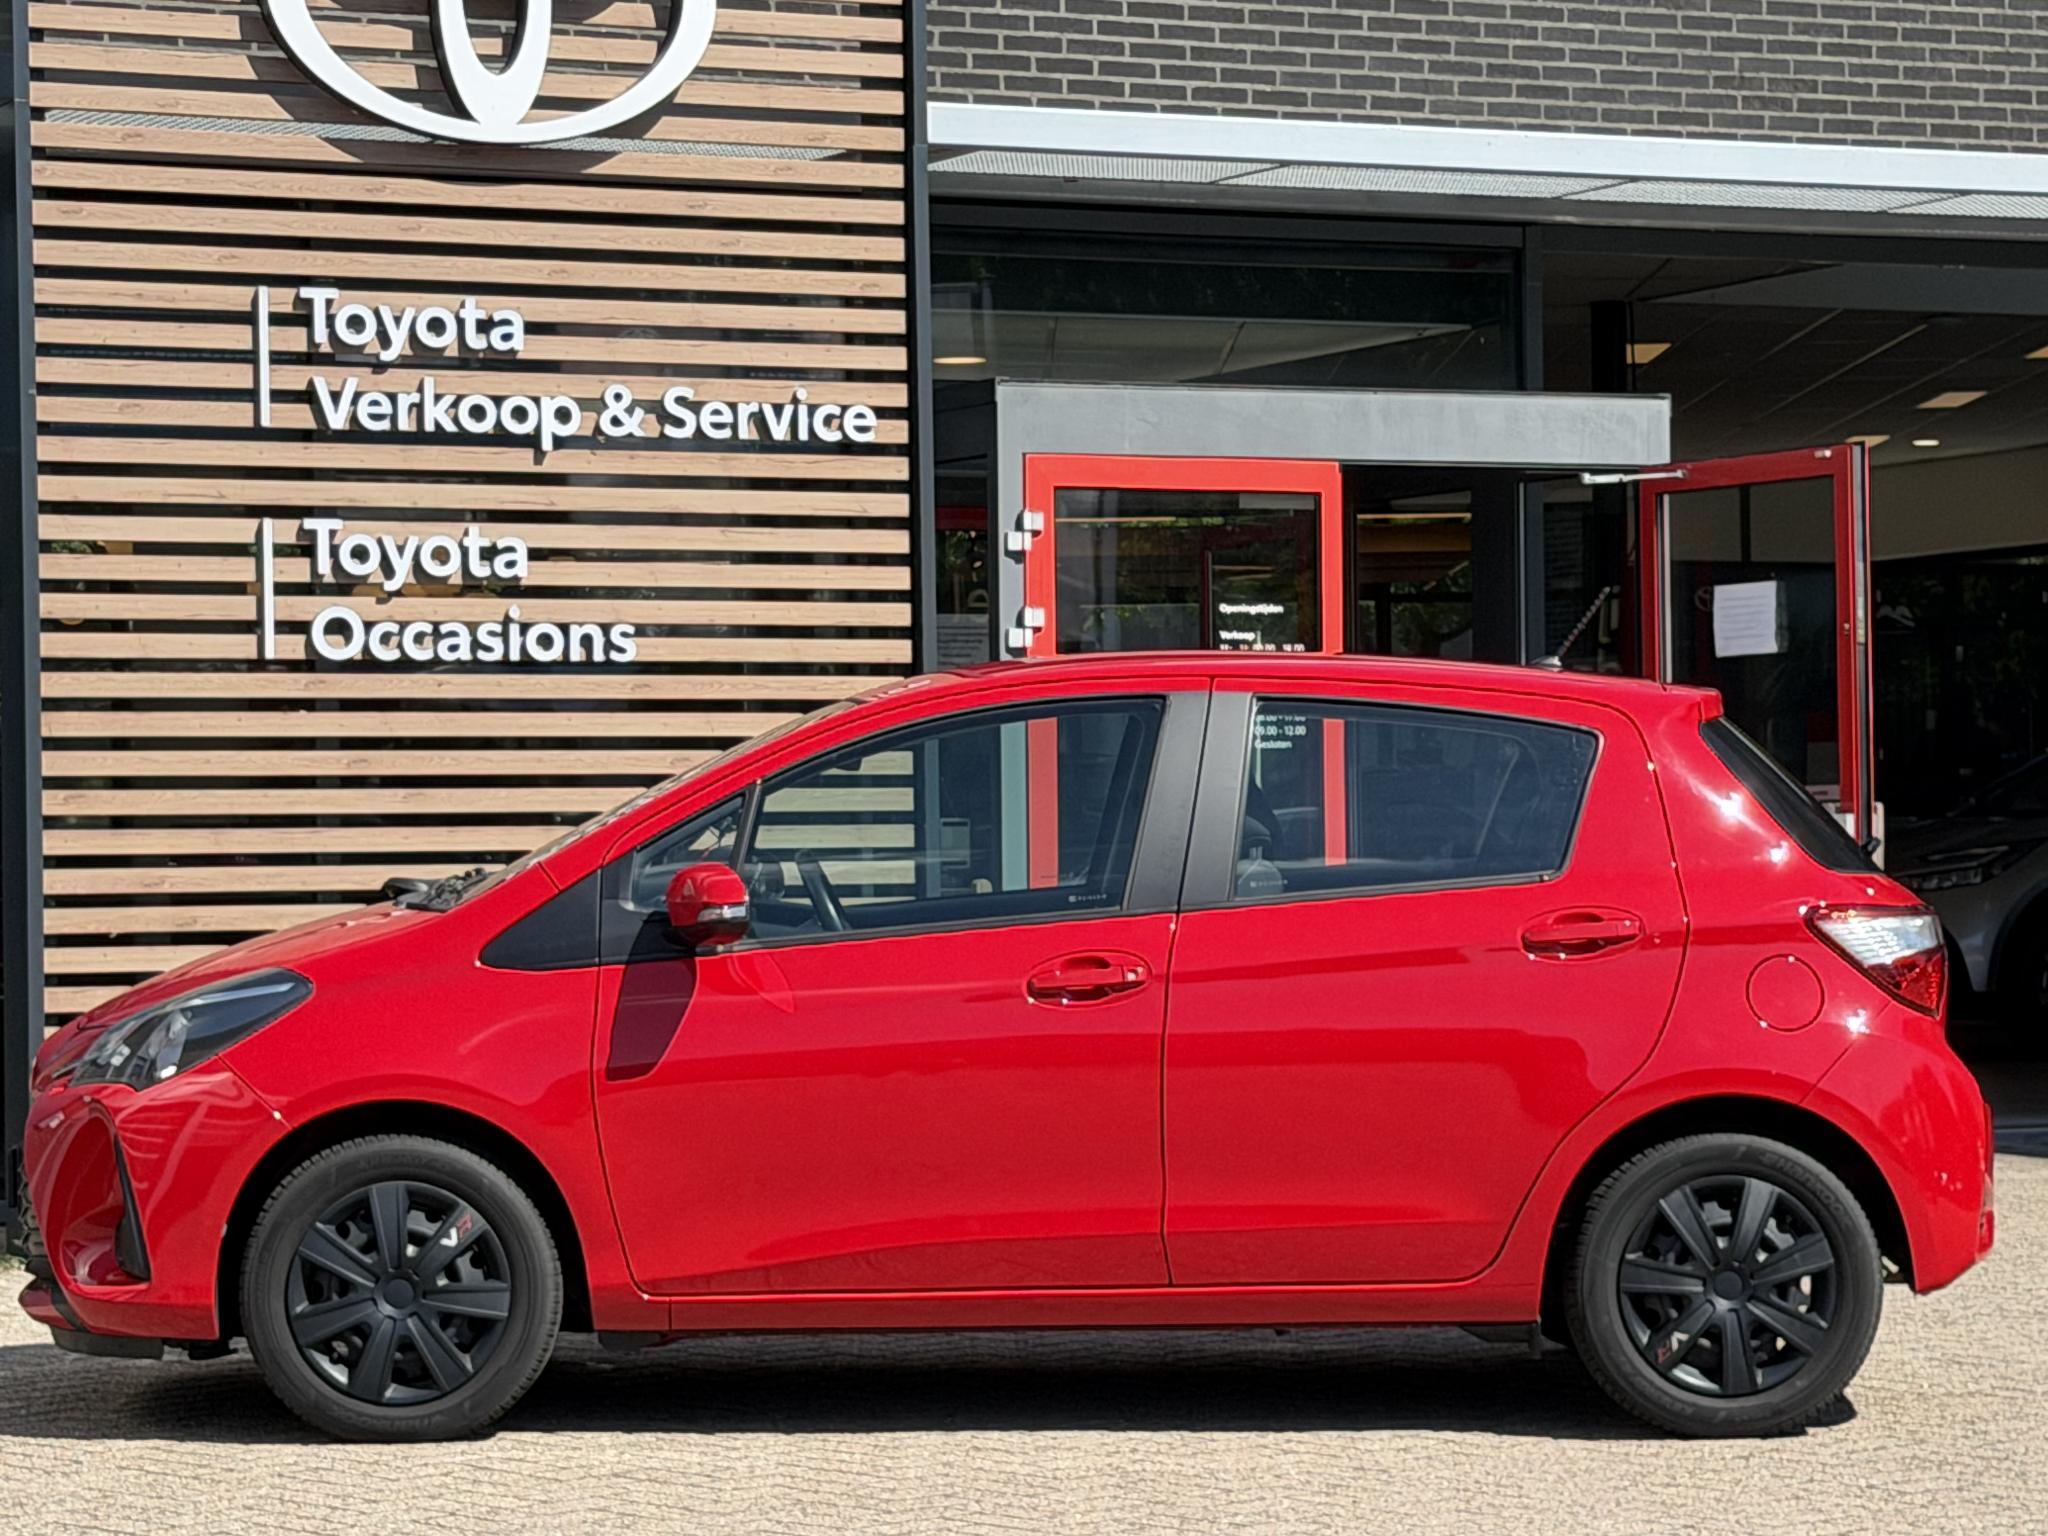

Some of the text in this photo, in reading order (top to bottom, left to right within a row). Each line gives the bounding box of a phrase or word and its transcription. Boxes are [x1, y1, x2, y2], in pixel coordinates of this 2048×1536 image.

[299, 286, 525, 362] Toyota
[309, 376, 878, 451] Verkoop & Service
[301, 517, 529, 592] Toyota
[310, 604, 637, 663] Occasions
